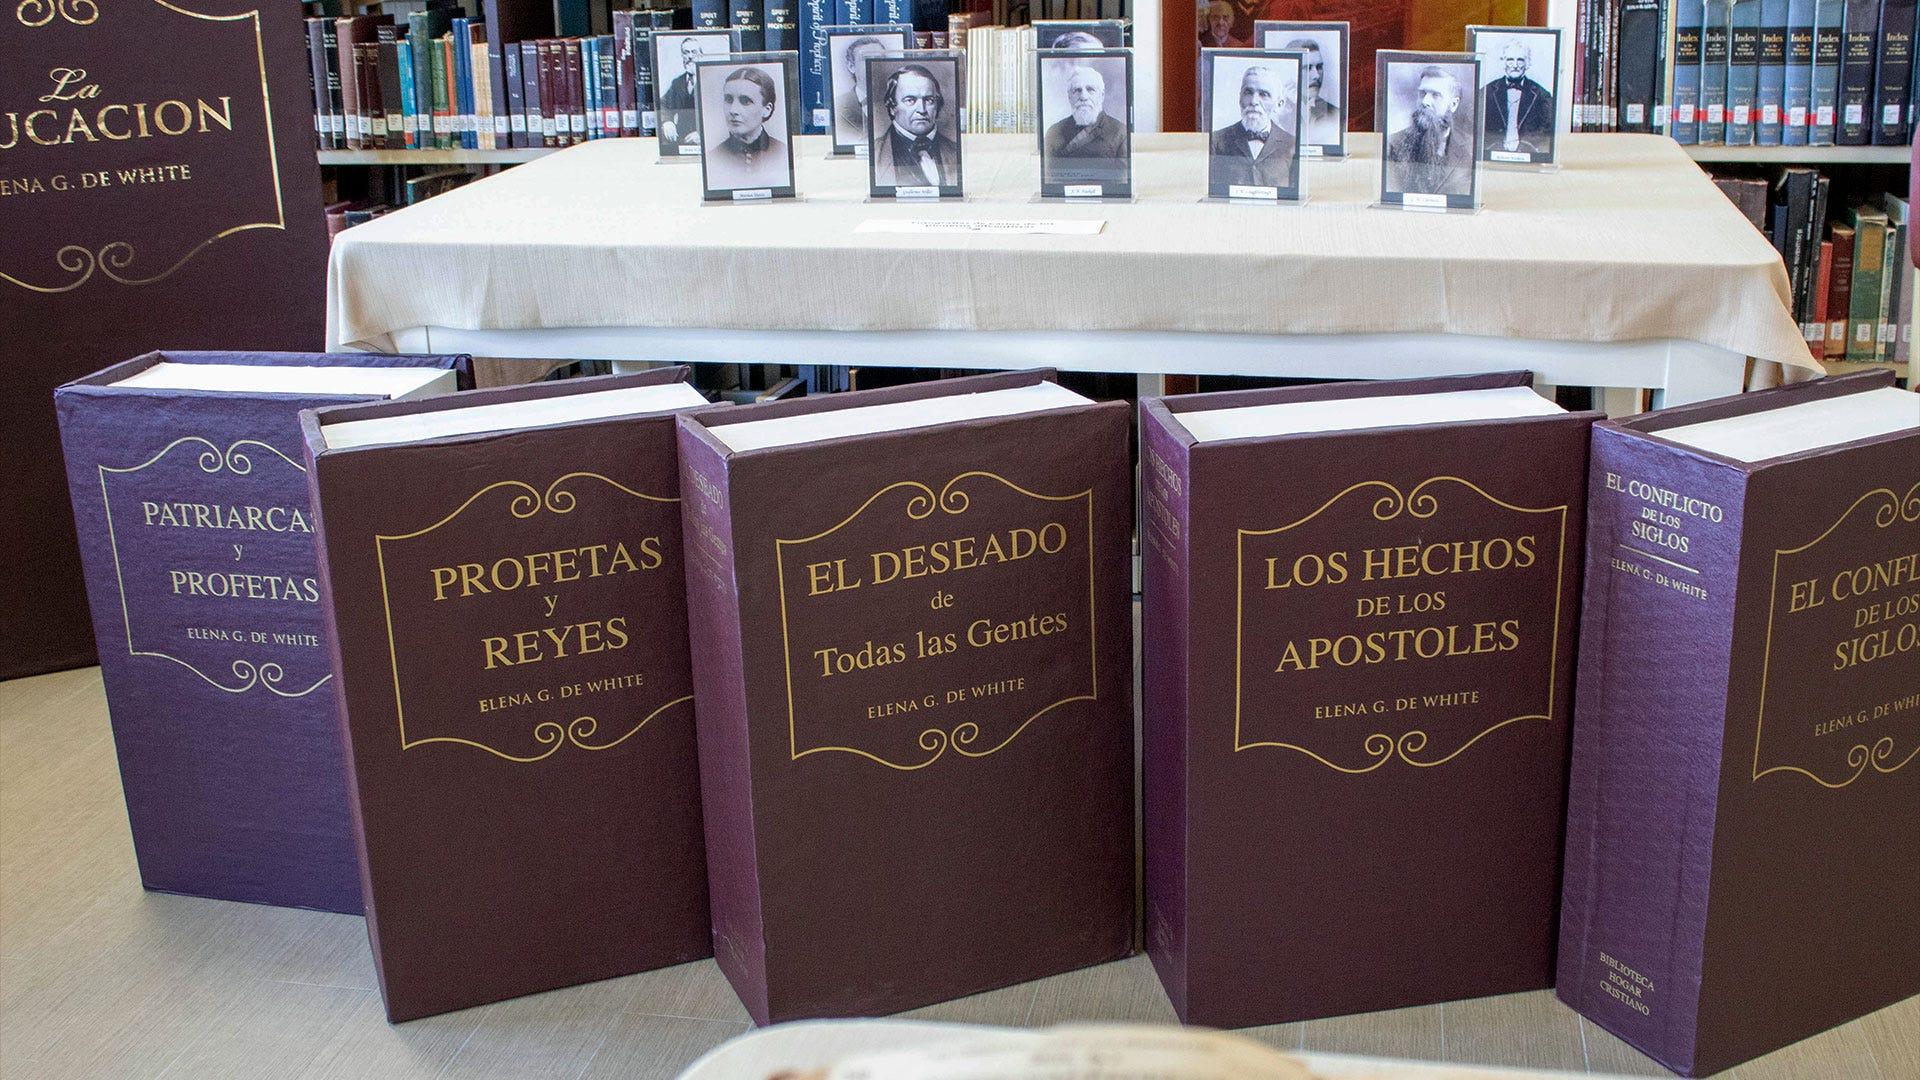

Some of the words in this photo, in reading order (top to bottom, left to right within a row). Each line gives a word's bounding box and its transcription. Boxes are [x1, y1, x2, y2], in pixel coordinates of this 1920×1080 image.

[1678, 33, 1699, 42] Index
[1706, 33, 1727, 42] Index
[1734, 33, 1756, 42] Index
[1762, 34, 1784, 43] Index
[1791, 33, 1812, 43] Index
[1818, 34, 1840, 43] Index
[1848, 33, 1870, 42] Index
[1886, 32, 1909, 42] Index
[39, 67, 102, 103] La
[51, 175, 76, 191] G.
[82, 170, 111, 189] DE
[116, 164, 192, 185] WHITE
[1606, 472, 1626, 493] EL
[1628, 480, 1723, 523] CONFLICTO
[141, 501, 315, 533] PATRIARCA
[1641, 506, 1657, 522] DE
[1659, 512, 1681, 529] LOS
[233, 543, 244, 561] y
[1631, 520, 1689, 553] SIGLOS
[430, 536, 663, 601] PROFETAS
[806, 558, 861, 597] EL
[870, 522, 1067, 585] DESEADO
[1264, 551, 1348, 590] LOS
[1361, 535, 1536, 582] HECHOS
[170, 570, 319, 603] PROFETAS
[1611, 558, 1640, 577] ELENA
[1642, 568, 1653, 581] G.
[1655, 573, 1670, 588] DE
[1671, 579, 1708, 600] WHITE
[543, 594, 558, 617] y
[930, 590, 954, 610] de
[1356, 596, 1391, 618] DE
[1397, 591, 1446, 615] LOS
[1788, 578, 1825, 614] EL
[1854, 604, 1880, 629] DE
[1884, 593, 1920, 620] LOS
[187, 627, 229, 641] ELENA
[233, 630, 247, 643] G.
[251, 631, 268, 644] DE
[273, 633, 319, 647] WHITE
[481, 616, 629, 670] REYES
[814, 640, 906, 678] Todas
[916, 631, 957, 659] las
[966, 611, 1068, 648] Gentes
[1274, 619, 1520, 673] APOSTOLES
[1834, 623, 1920, 671] SIGLO
[479, 692, 532, 713] ELENA
[537, 689, 554, 702] G.
[560, 683, 582, 699] DE
[586, 673, 644, 695] WHITE
[867, 699, 918, 720] ELENA
[923, 694, 939, 708] G.
[946, 688, 967, 704] DE
[971, 677, 1025, 699] WHITE
[1314, 702, 1367, 719] ELENA
[1372, 700, 1389, 713] G.
[1395, 696, 1417, 712] DE
[1422, 690, 1480, 709] WHITE
[1814, 714, 1853, 737] ELENA
[1857, 710, 1869, 724] G.
[1873, 703, 1890, 720] DE
[1600, 951, 1655, 992] BIBLIOTECA
[1609, 971, 1641, 998] HOGAR
[1600, 980, 1650, 1015] CRISTIANO
